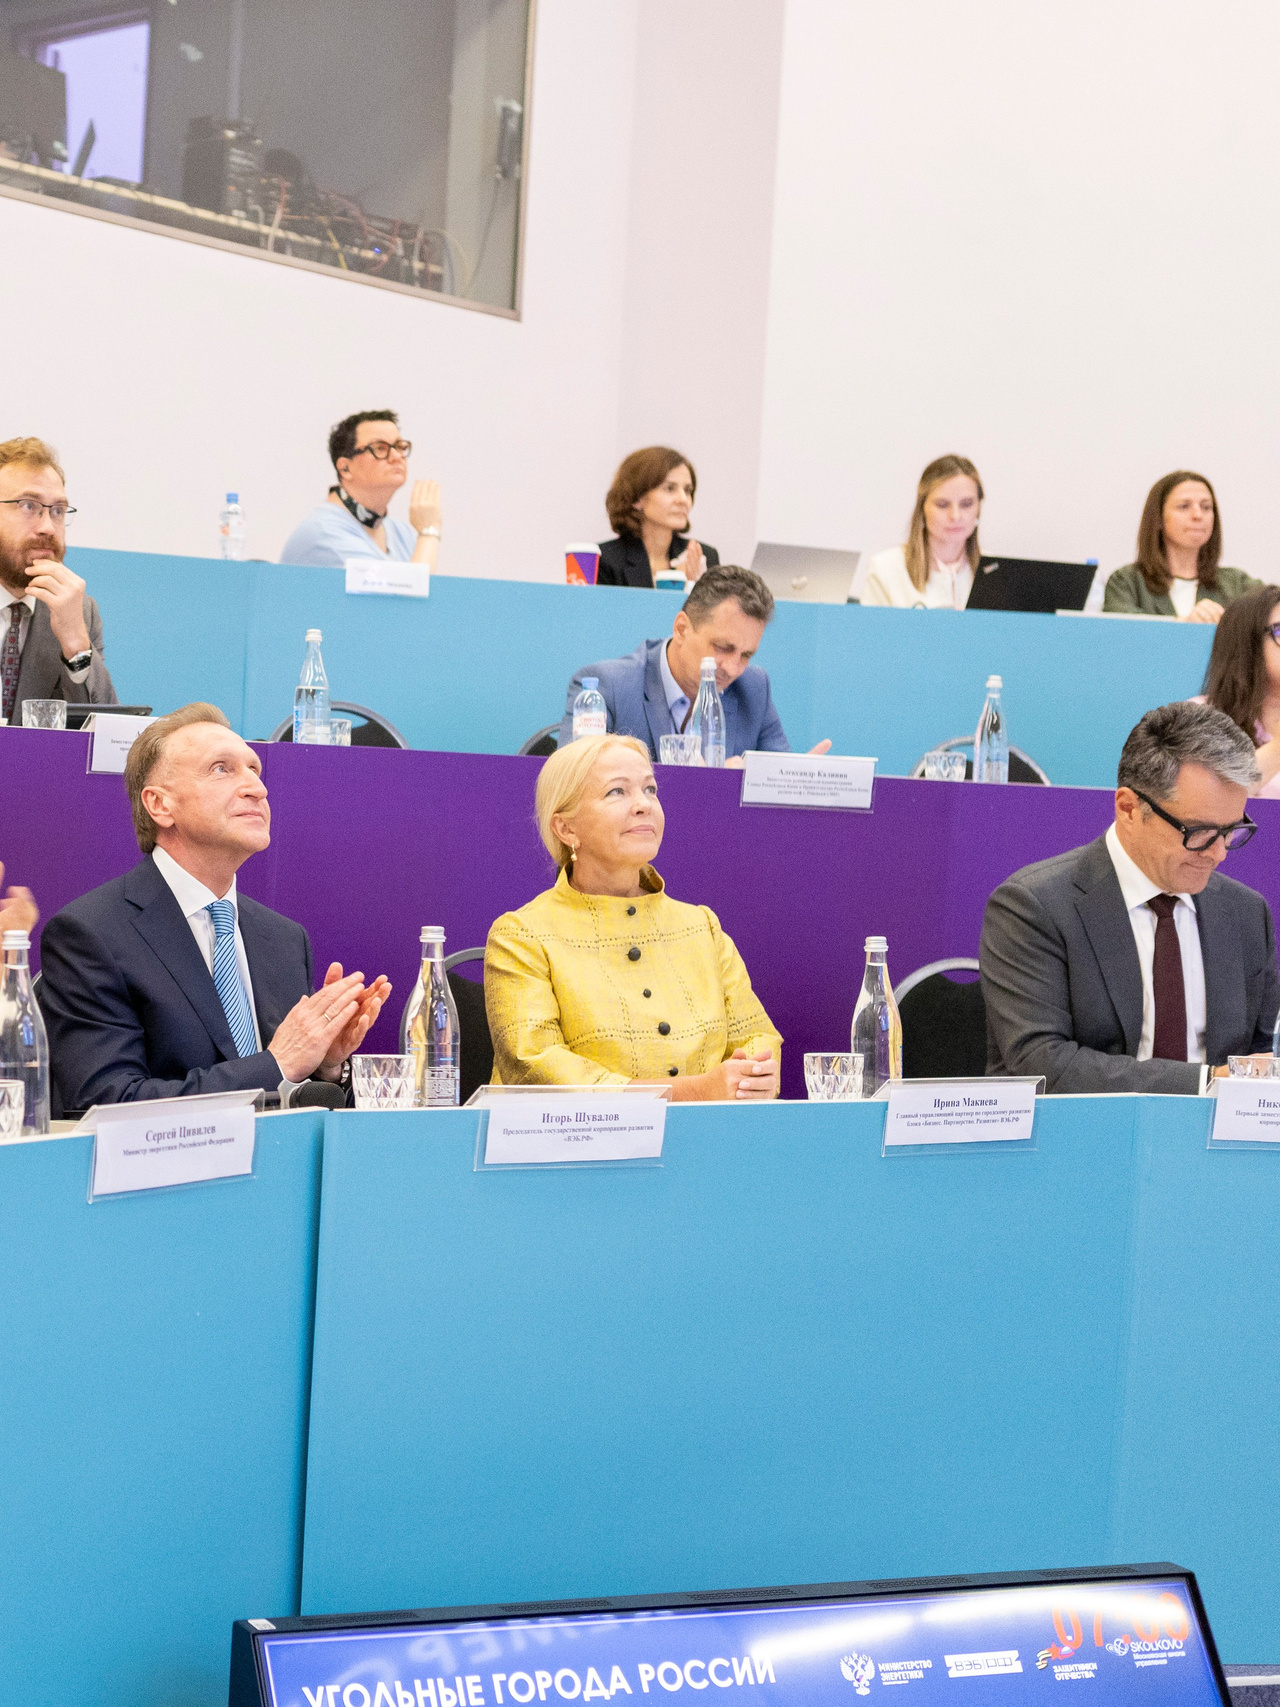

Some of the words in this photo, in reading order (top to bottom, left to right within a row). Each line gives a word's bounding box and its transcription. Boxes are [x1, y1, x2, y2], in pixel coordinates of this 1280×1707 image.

[779, 769, 816, 778] Александр
[817, 770, 848, 779] Калинин
[933, 1098, 960, 1111] Ирина
[962, 1097, 998, 1107] Макиева
[542, 1112, 572, 1125] Игорь
[575, 1112, 620, 1125] Шувалов
[919, 1111, 954, 1119] управляющий
[145, 1128, 177, 1144] Сергей
[179, 1125, 216, 1139] Цивилев
[502, 1128, 544, 1136] Председатель
[544, 1126, 592, 1135] государственной
[593, 1126, 627, 1134] корпорации
[628, 1124, 654, 1133] развития
[123, 1148, 147, 1157] Министр
[178, 1140, 207, 1150] Российской
[208, 1137, 235, 1146] Федерации
[1130, 1638, 1184, 1653] SKOLKOVO
[878, 1659, 933, 1672] МИНИСТЕРСТВО
[1052, 1662, 1098, 1673] ЗАЩИТНИКИ
[302, 1674, 486, 1707] УГОЛЬНЫЕ
[491, 1665, 633, 1703] ГОРОДА
[637, 1656, 777, 1693] РОССИИ
[880, 1670, 924, 1682] ЭНЕРГЕТИКИ
[1055, 1671, 1096, 1681] ОТЕЧЕСТВА
